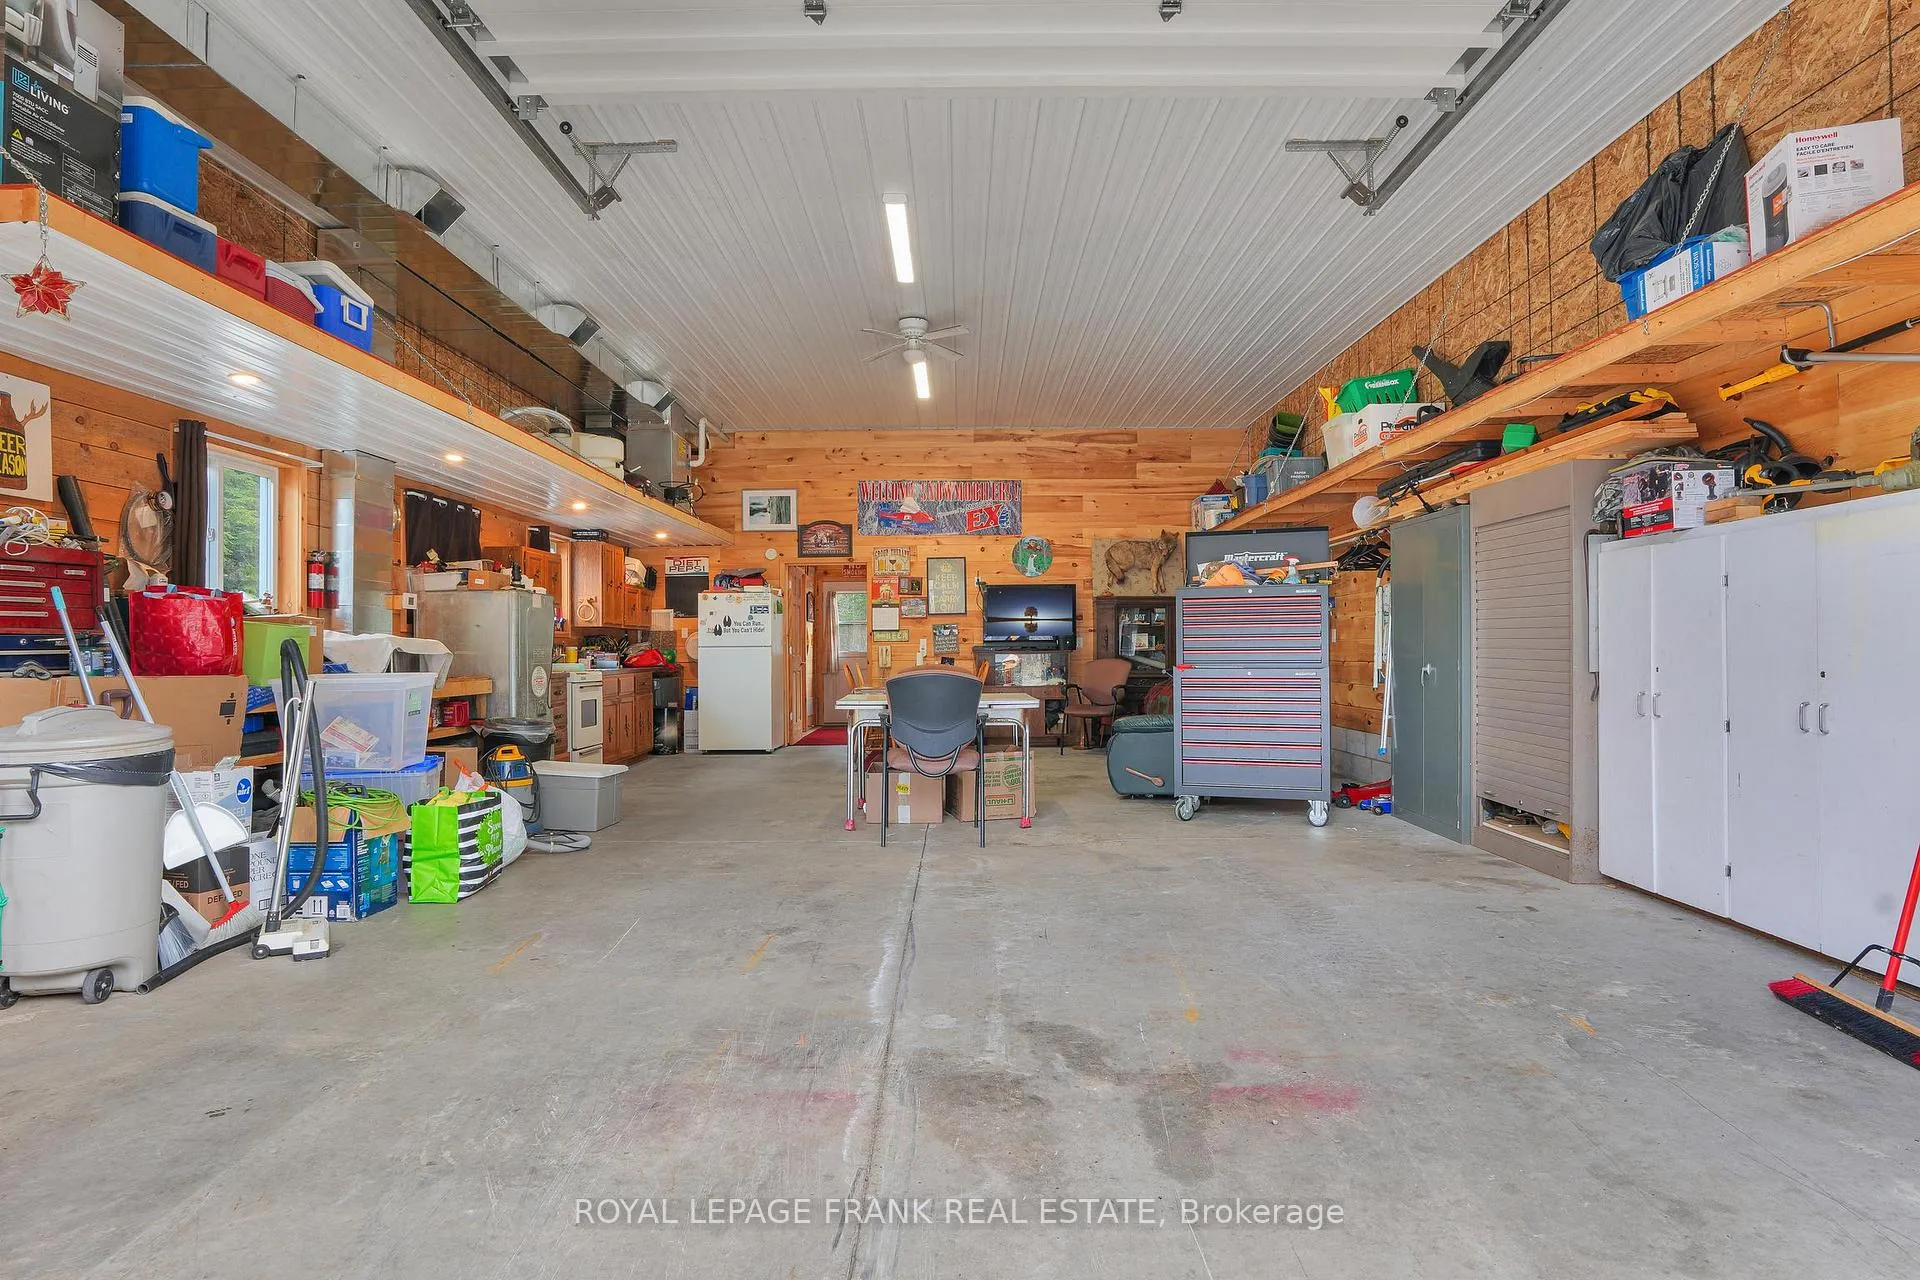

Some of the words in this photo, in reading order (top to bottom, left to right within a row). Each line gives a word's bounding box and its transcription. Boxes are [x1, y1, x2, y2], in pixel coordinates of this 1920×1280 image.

[30, 86, 69, 115] LIVING
[1796, 131, 1838, 143] Honeywell
[0, 453, 26, 477] ASON
[669, 565, 705, 573] PEPSI
